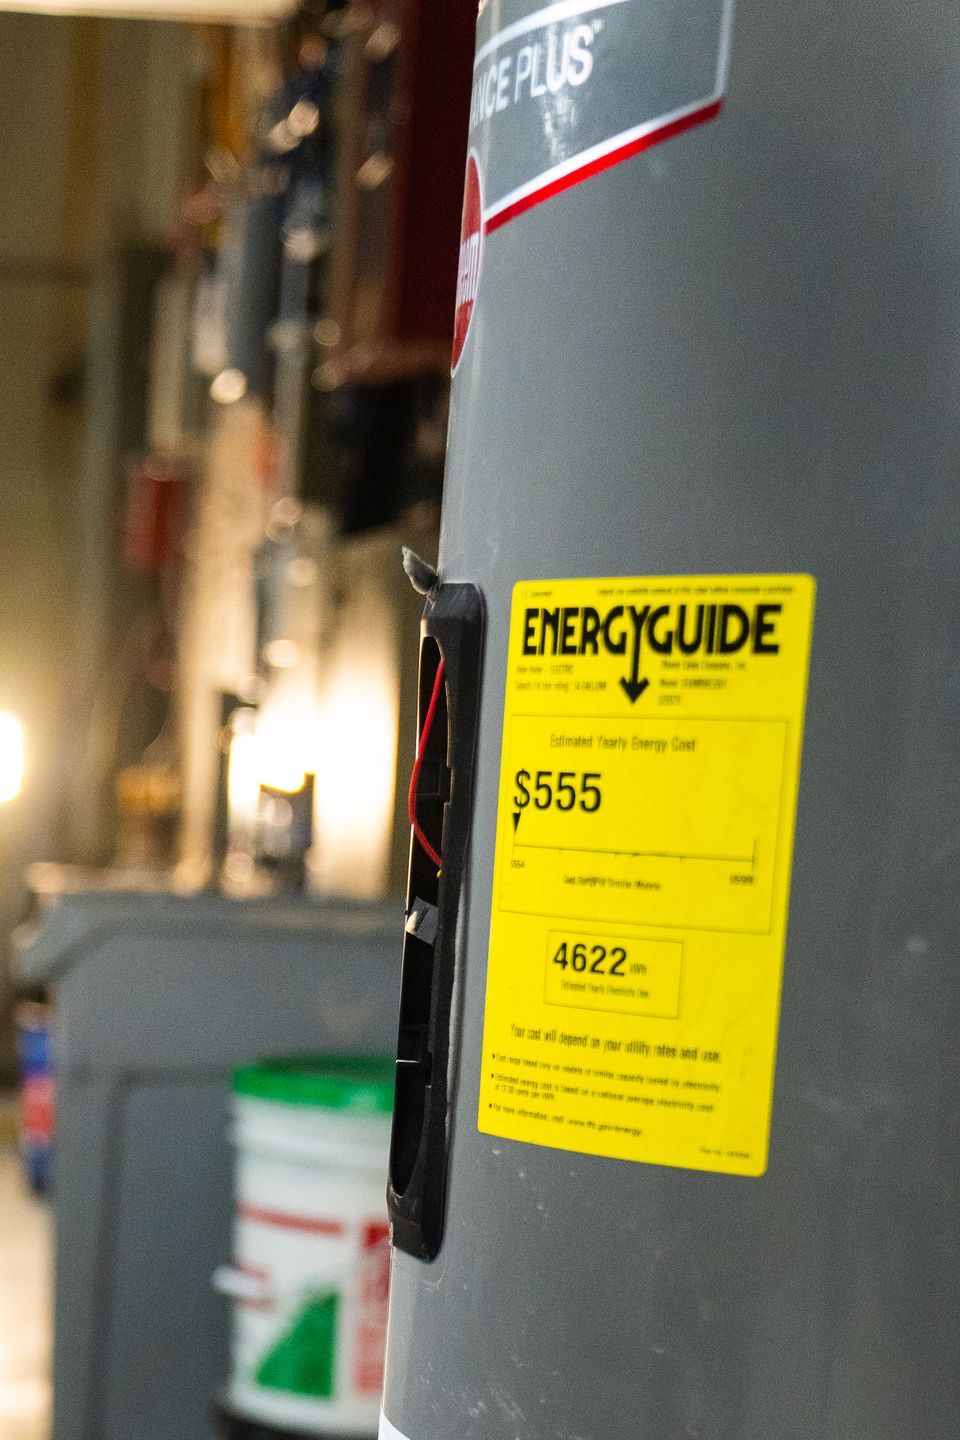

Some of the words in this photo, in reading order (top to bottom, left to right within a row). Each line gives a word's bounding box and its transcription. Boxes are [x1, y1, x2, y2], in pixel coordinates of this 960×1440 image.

[515, 24, 594, 104] PLUS
[522, 604, 782, 657] ENERGYGUIDE
[550, 734, 592, 750] Estimated
[596, 736, 628, 752] Yearly
[631, 737, 668, 754] Energy
[671, 738, 696, 753] Cost
[514, 768, 602, 813] $555
[553, 941, 627, 977] 4622
[511, 1023, 526, 1039] Your
[527, 1028, 542, 1042] cost
[544, 1029, 557, 1044] will
[559, 1032, 588, 1050] depend
[590, 1038, 600, 1050] on
[603, 1039, 622, 1055] your
[625, 1040, 651, 1060] utility
[653, 1044, 677, 1060] rates
[679, 1047, 698, 1062] and
